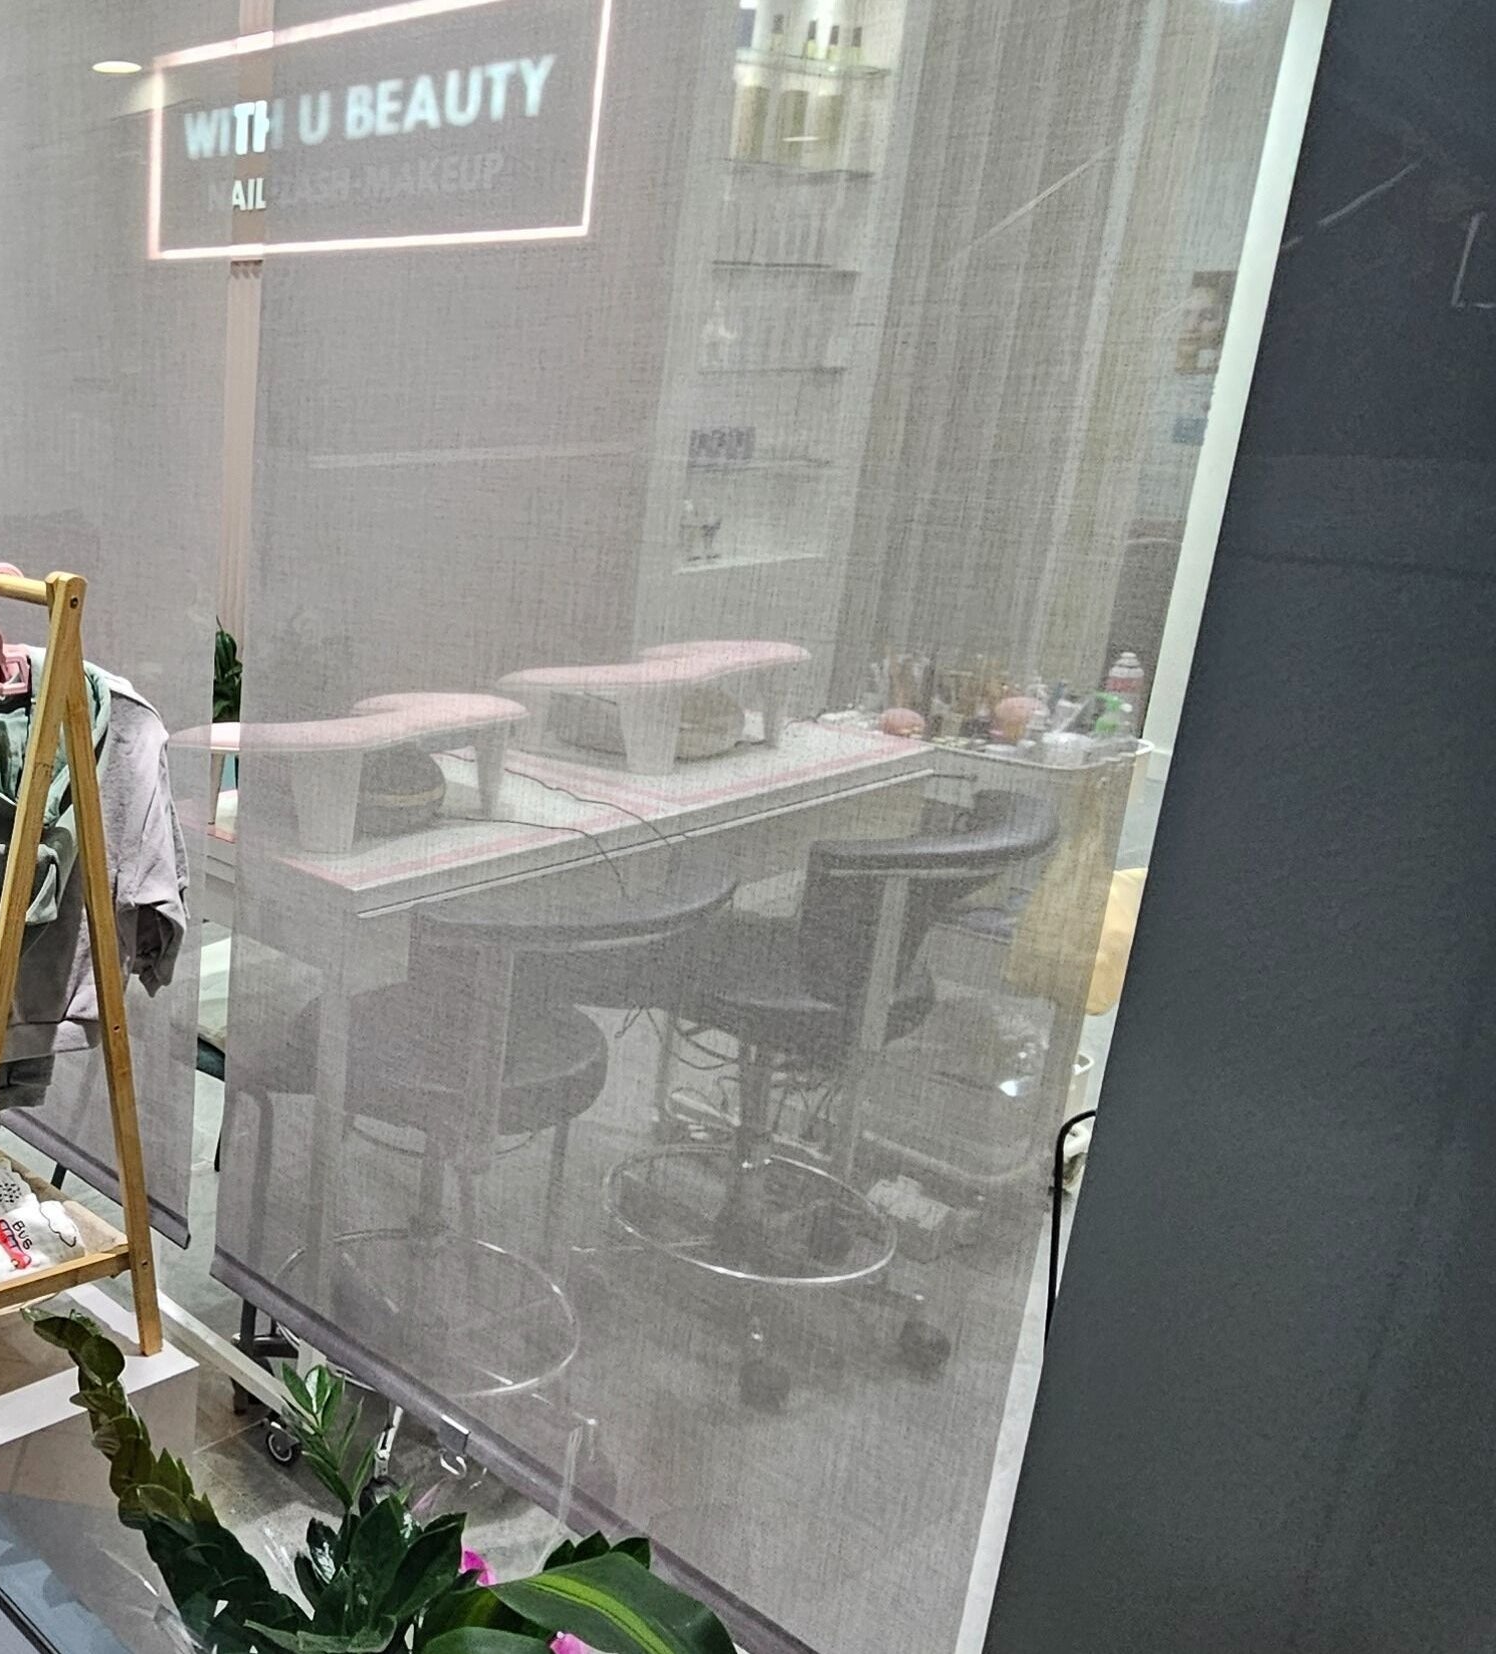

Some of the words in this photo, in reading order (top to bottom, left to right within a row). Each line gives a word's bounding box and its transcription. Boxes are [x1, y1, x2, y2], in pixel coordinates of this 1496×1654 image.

[184, 100, 283, 160] WITH
[298, 90, 331, 145] U
[344, 53, 557, 140] BEAUTY
[12, 1220, 33, 1250] BUS
